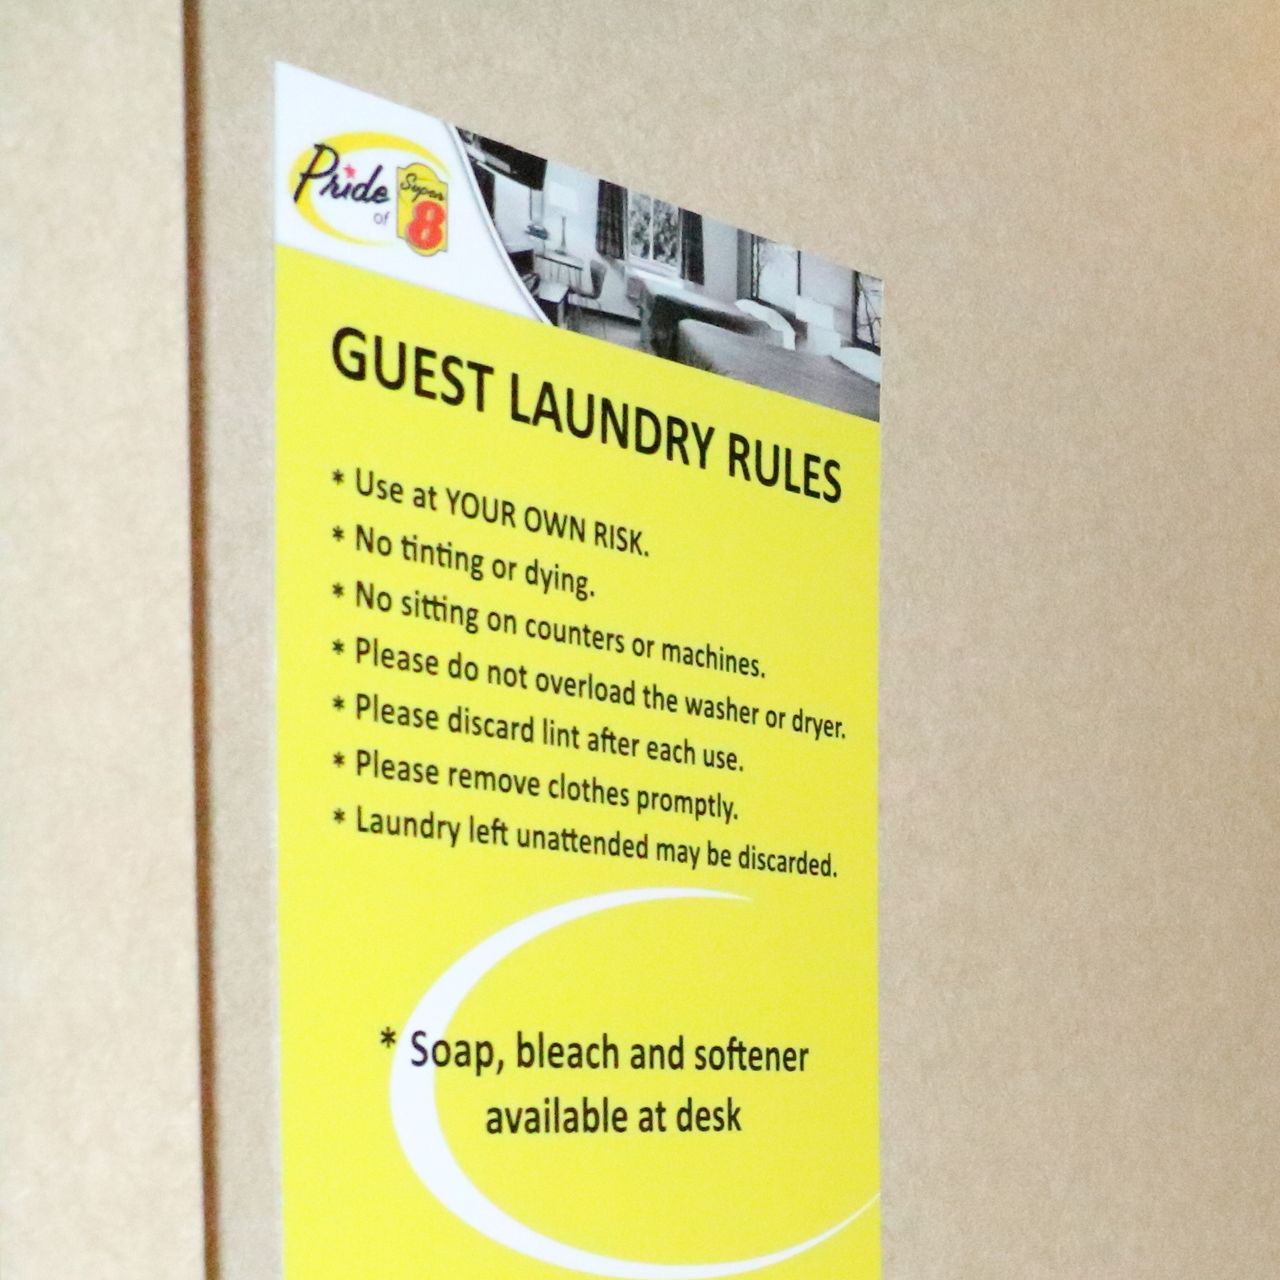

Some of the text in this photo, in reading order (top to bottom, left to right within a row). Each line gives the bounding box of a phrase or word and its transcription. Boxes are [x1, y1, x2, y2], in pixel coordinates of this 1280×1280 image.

[294, 143, 390, 204] Pride
[400, 173, 444, 202] Super
[373, 211, 390, 226] of
[407, 201, 445, 250] 8
[332, 327, 841, 503] GUEST LAUNDRY RULES
[356, 468, 650, 556] Use at YOUR OWN RISK.
[357, 525, 595, 601] No tinting or dying.
[357, 581, 766, 678] No sitting on counters or machines.
[357, 637, 846, 739] Please do not overload the washer or dryer.
[357, 693, 743, 772] Please discard lint after each use.
[357, 750, 738, 820] Please remove clothes promptly.
[358, 806, 838, 878] Laundry left unattended may be discarded.
[411, 1030, 809, 1076] Soap, bleach and softener
[487, 1097, 741, 1134] available at desk
